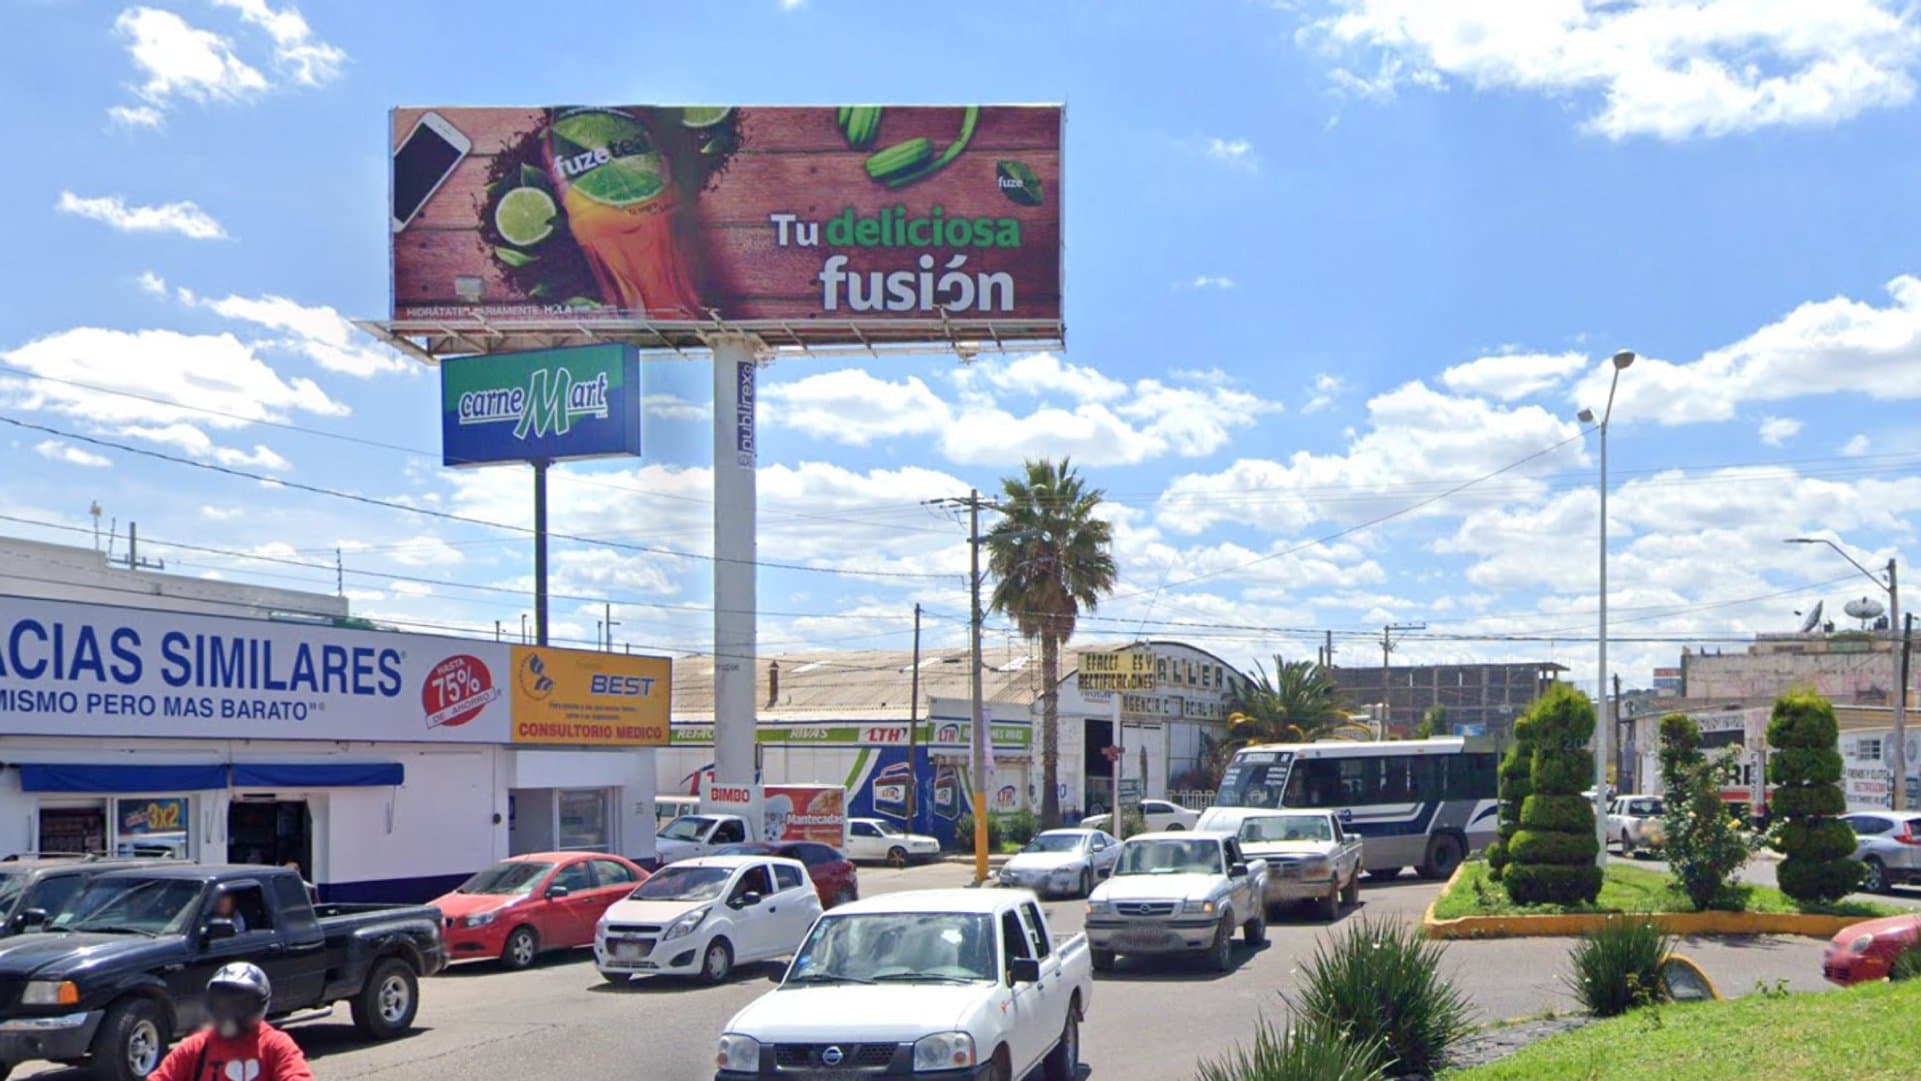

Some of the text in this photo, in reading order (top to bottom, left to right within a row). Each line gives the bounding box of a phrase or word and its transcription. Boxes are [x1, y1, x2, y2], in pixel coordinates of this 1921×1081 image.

[998, 175, 1024, 188] fuze
[770, 204, 1022, 249] Tu deliciosa
[819, 253, 1015, 312] fusión
[0, 617, 402, 698] CIAS SIMILARES
[431, 663, 481, 708] 75%
[590, 673, 656, 698] BEST
[1157, 657, 1224, 690] ALLER
[86, 693, 156, 718] PERO
[163, 697, 214, 719] MAS
[518, 722, 663, 741] CONSULTORIO MEDICO
[867, 726, 901, 742] LTH
